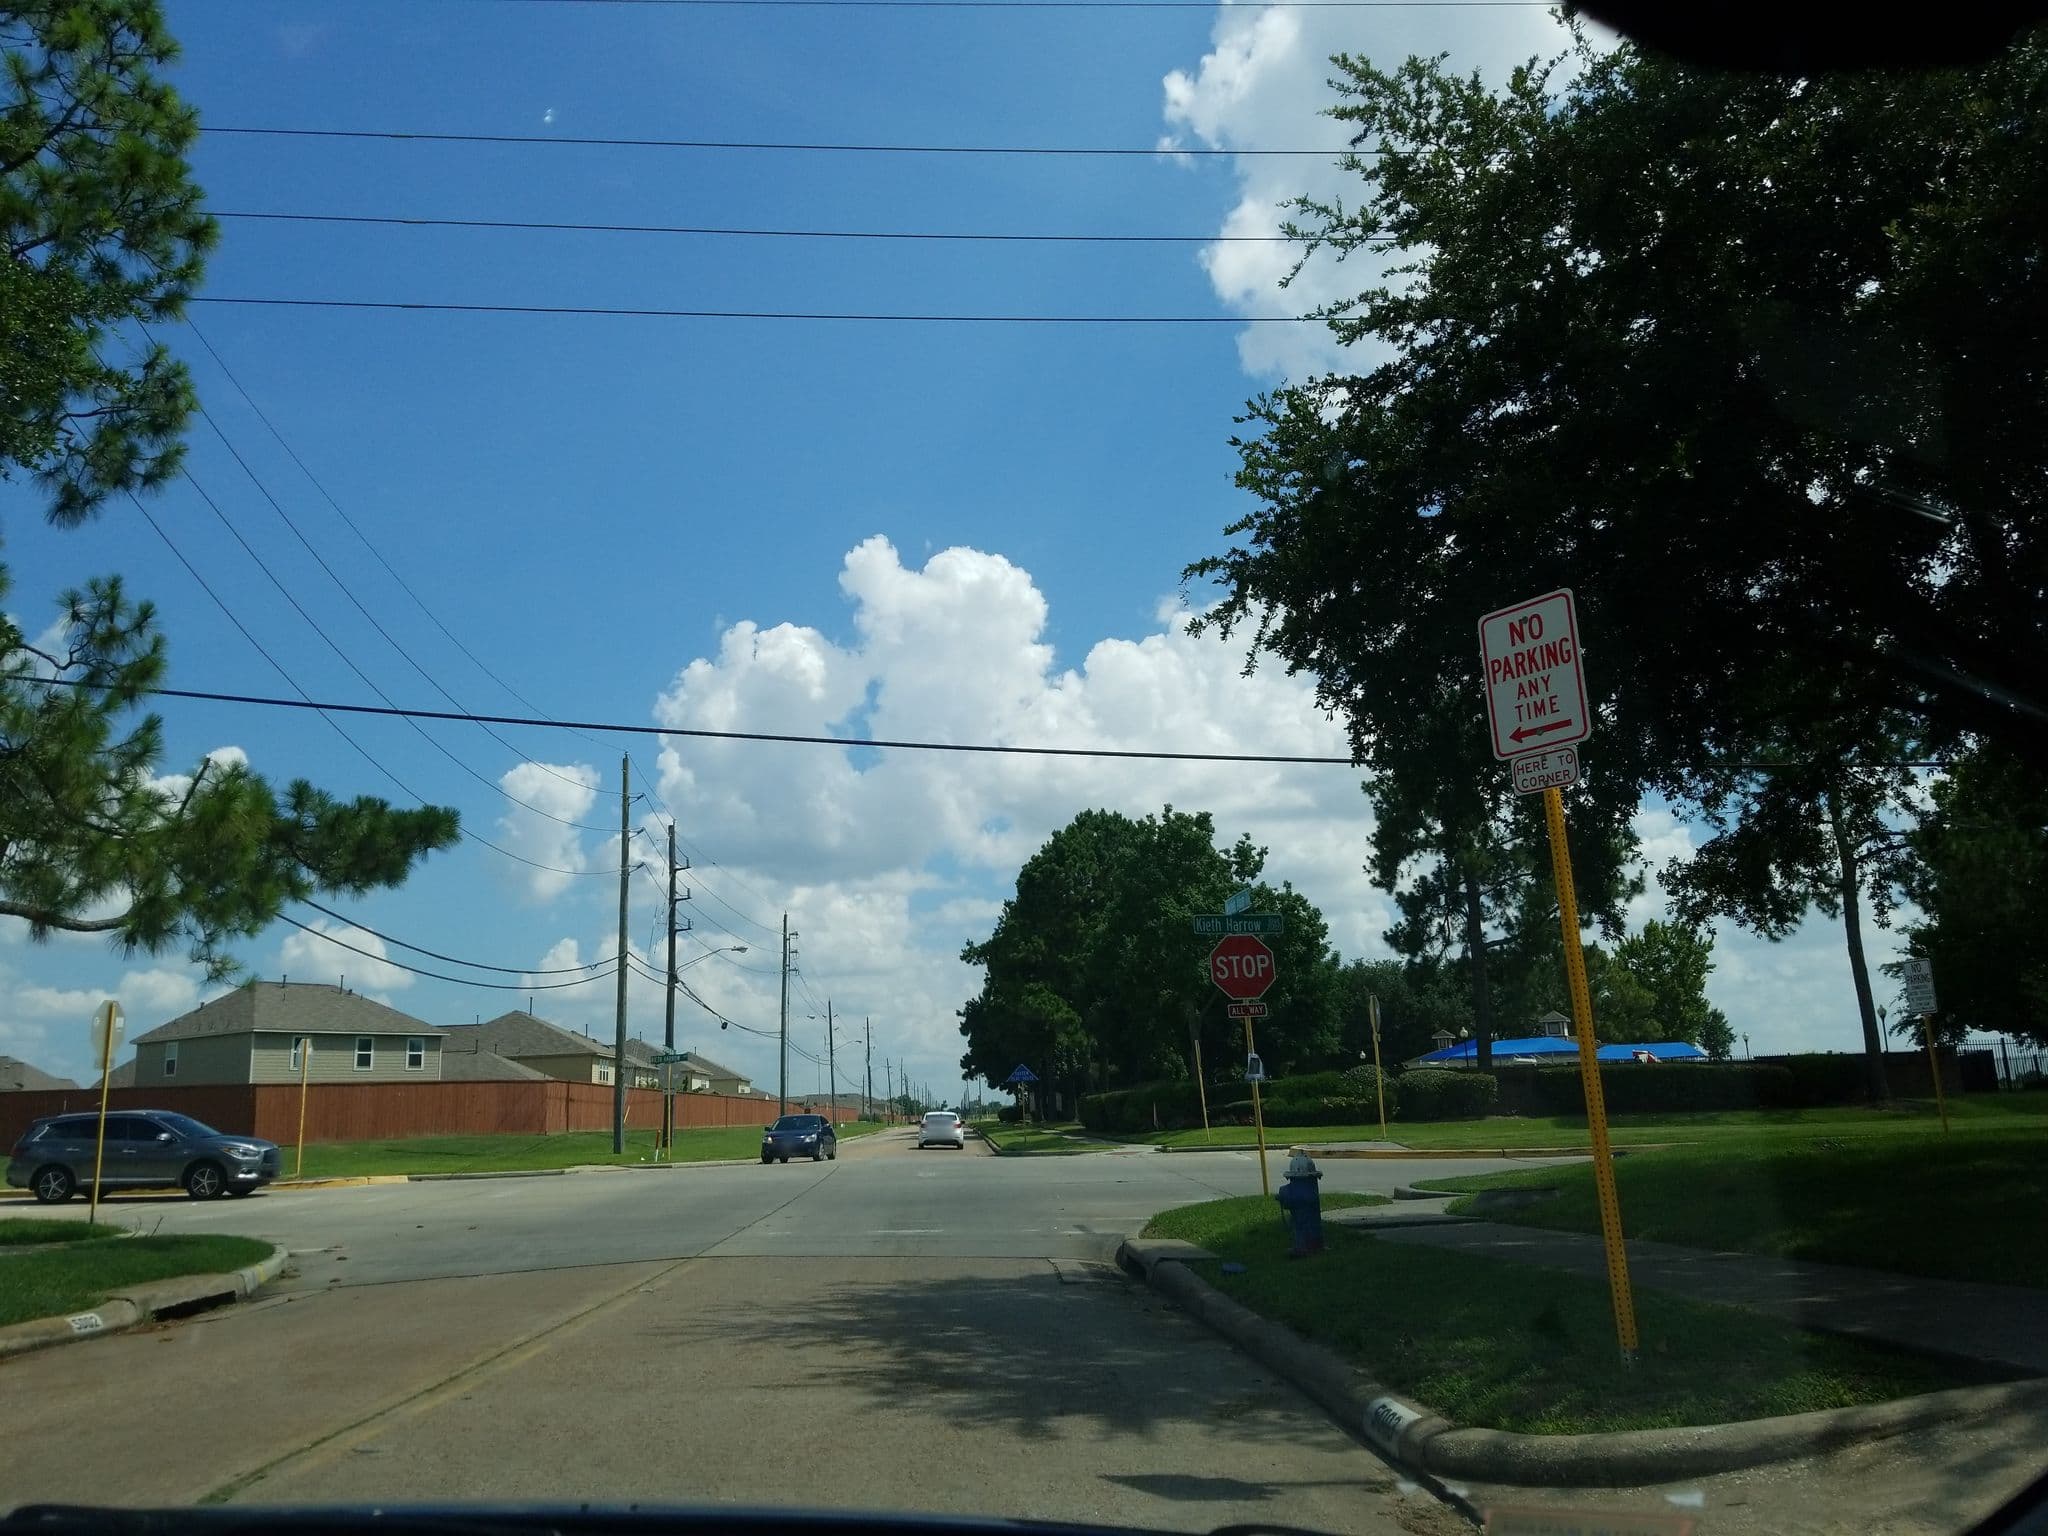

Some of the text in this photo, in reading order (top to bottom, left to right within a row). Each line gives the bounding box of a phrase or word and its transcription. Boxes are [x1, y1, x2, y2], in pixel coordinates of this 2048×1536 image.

[1508, 614, 1544, 647] NO
[1490, 637, 1573, 685] PARKING
[1516, 674, 1551, 701] ANY
[1514, 694, 1561, 723] TIME
[1516, 752, 1574, 776] HERE TO
[1521, 768, 1572, 790] CORNER
[1196, 917, 1222, 932] Kieth
[1226, 917, 1261, 932] Harrow
[1215, 954, 1270, 980] STOP
[1911, 962, 1922, 973] NO
[1231, 1005, 1265, 1015] ALL WAY
